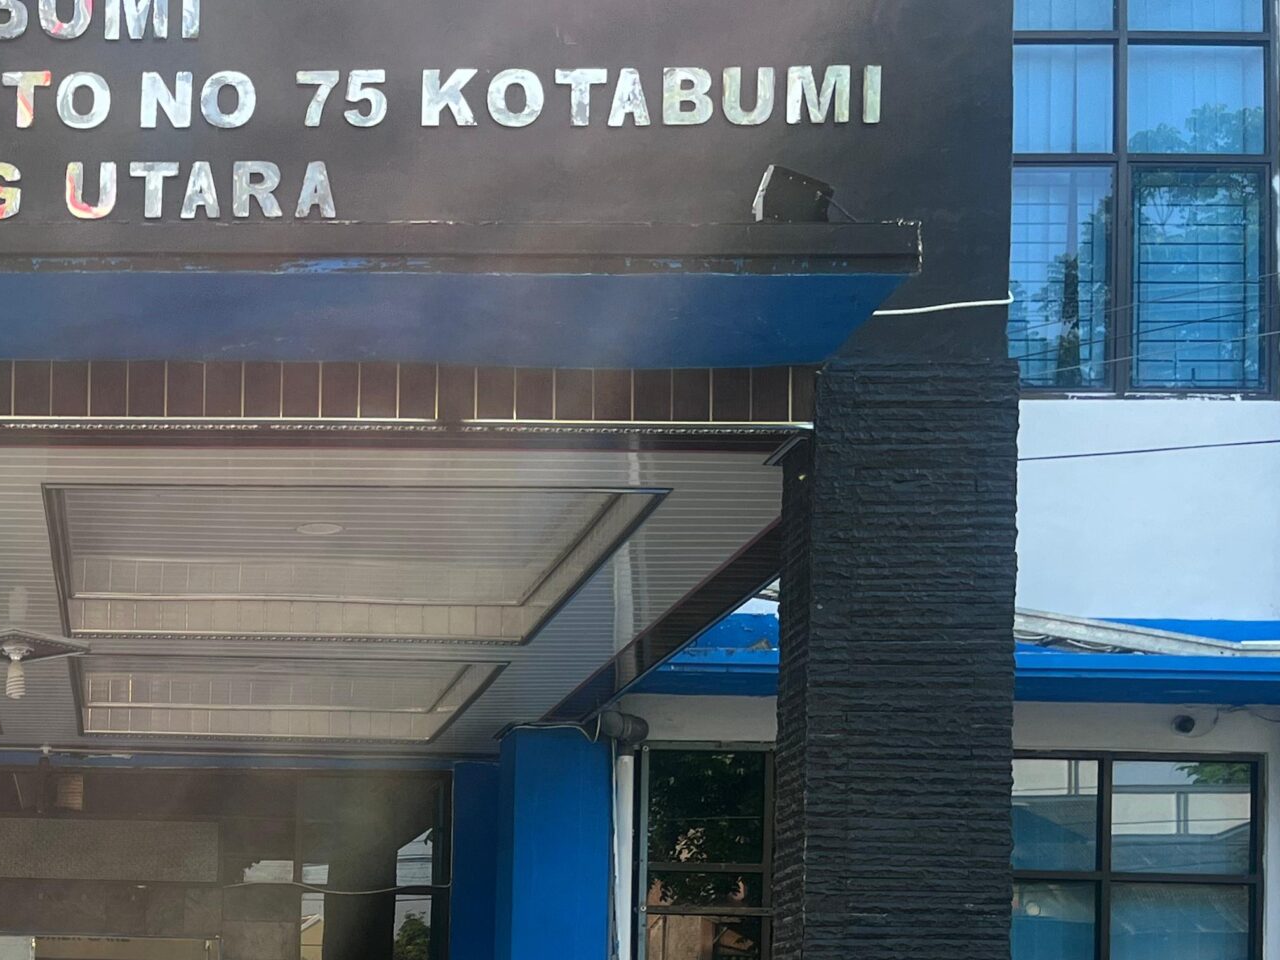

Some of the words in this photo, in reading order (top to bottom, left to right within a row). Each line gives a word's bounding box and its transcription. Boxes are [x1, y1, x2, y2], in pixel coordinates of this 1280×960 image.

[140, 71, 257, 128] NO
[295, 70, 387, 127] 75
[421, 65, 883, 128] KOTABUMI
[65, 160, 338, 219] UTARA
